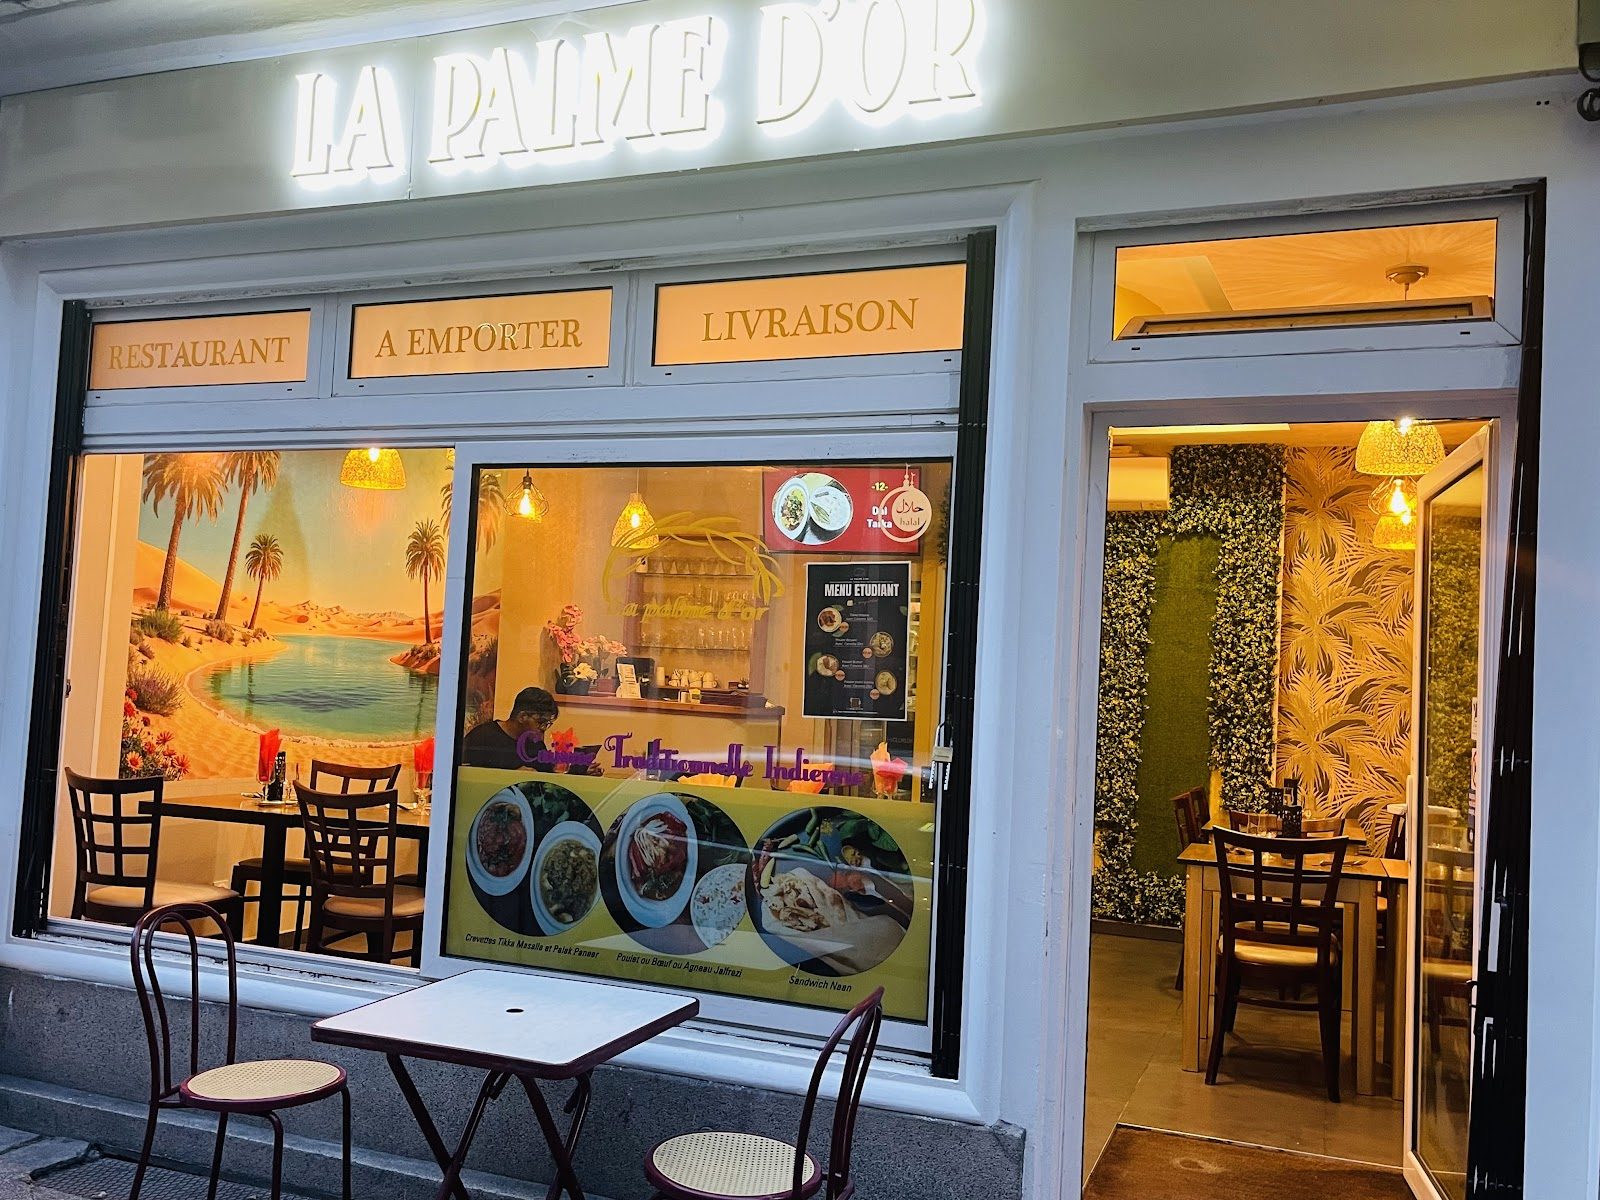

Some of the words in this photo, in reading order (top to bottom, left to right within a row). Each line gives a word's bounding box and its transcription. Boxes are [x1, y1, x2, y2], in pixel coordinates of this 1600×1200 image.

[291, 65, 393, 178] LA
[428, 17, 713, 164] PALME
[757, 0, 977, 124] D'OR
[701, 298, 919, 341] LIVRAISON
[108, 337, 291, 370] RESTAURANT
[375, 329, 398, 358] A
[406, 318, 583, 356] EMPORTER
[824, 583, 852, 597] MENU
[854, 583, 899, 597] ETUDIANT
[616, 952, 640, 963] Poulet
[683, 961, 713, 973] Agneau
[788, 975, 829, 989] Sandwich
[829, 981, 852, 992] Naan
